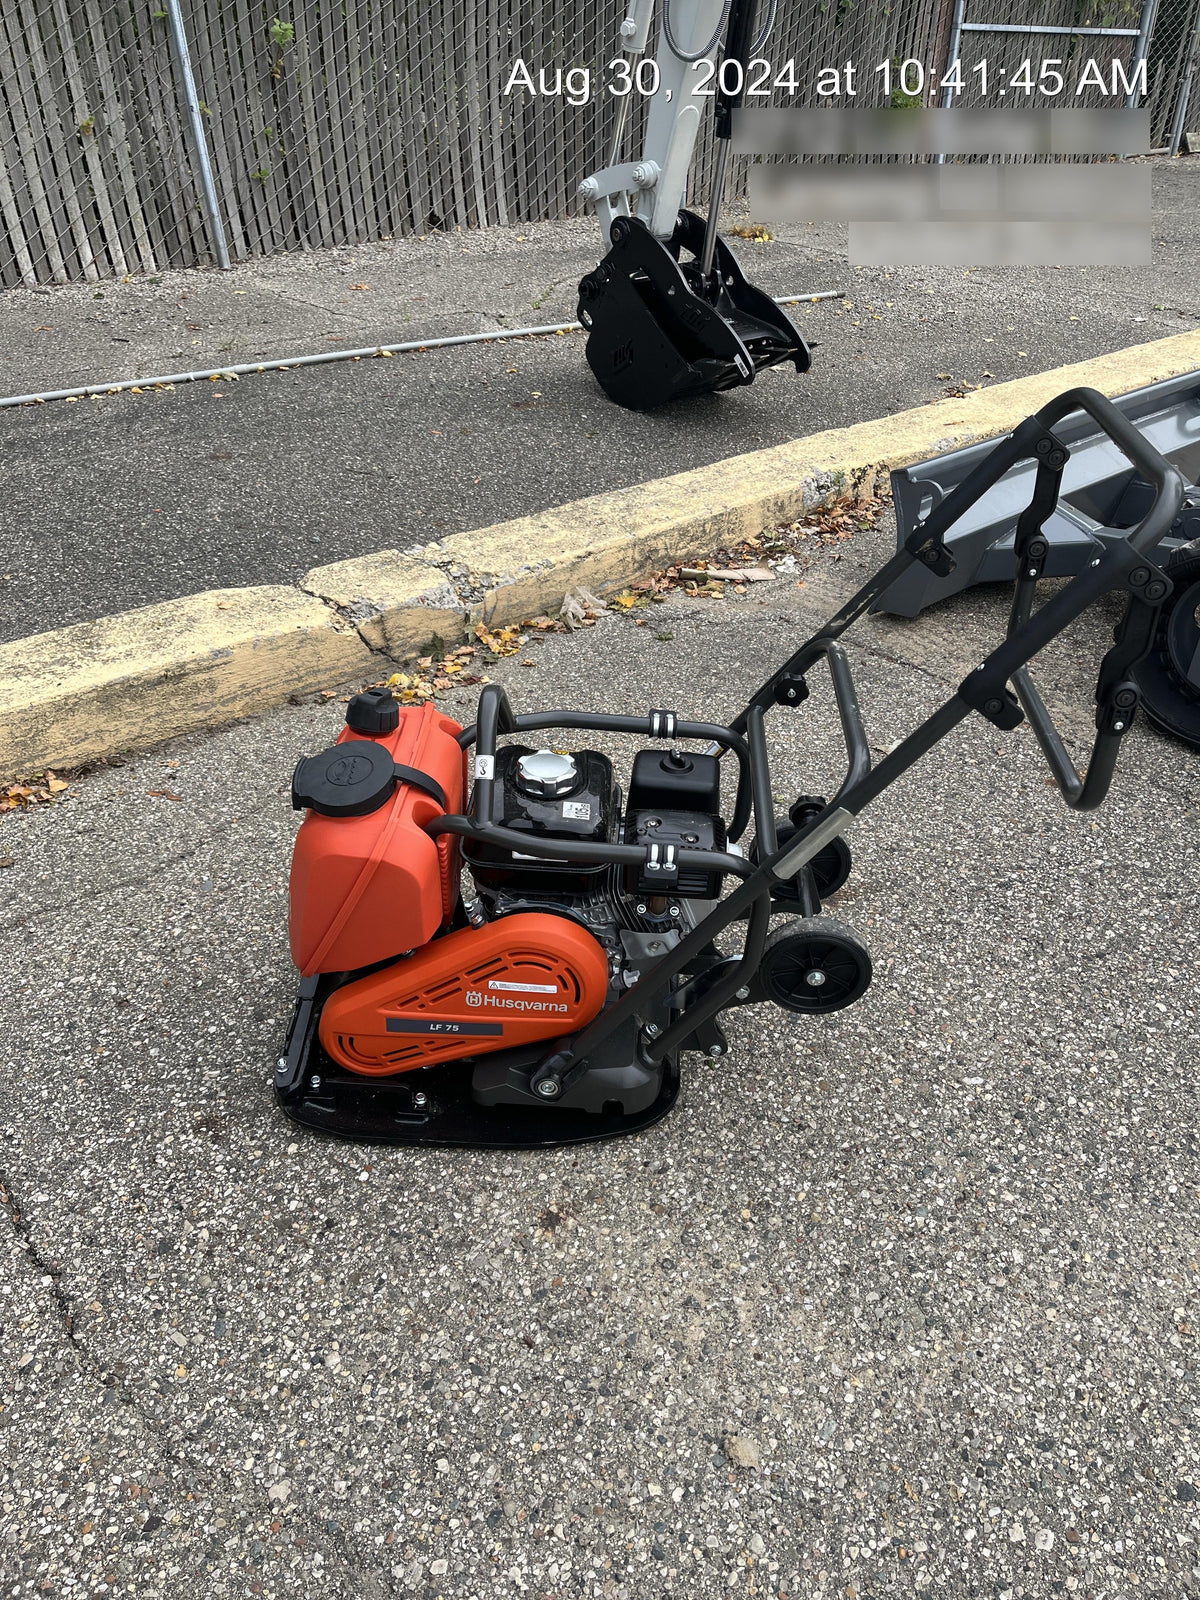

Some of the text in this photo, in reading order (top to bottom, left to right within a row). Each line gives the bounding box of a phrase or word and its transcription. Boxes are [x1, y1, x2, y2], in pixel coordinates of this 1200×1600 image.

[483, 994, 568, 1012] Husqvarna
[429, 1023, 460, 1032] LF 75
